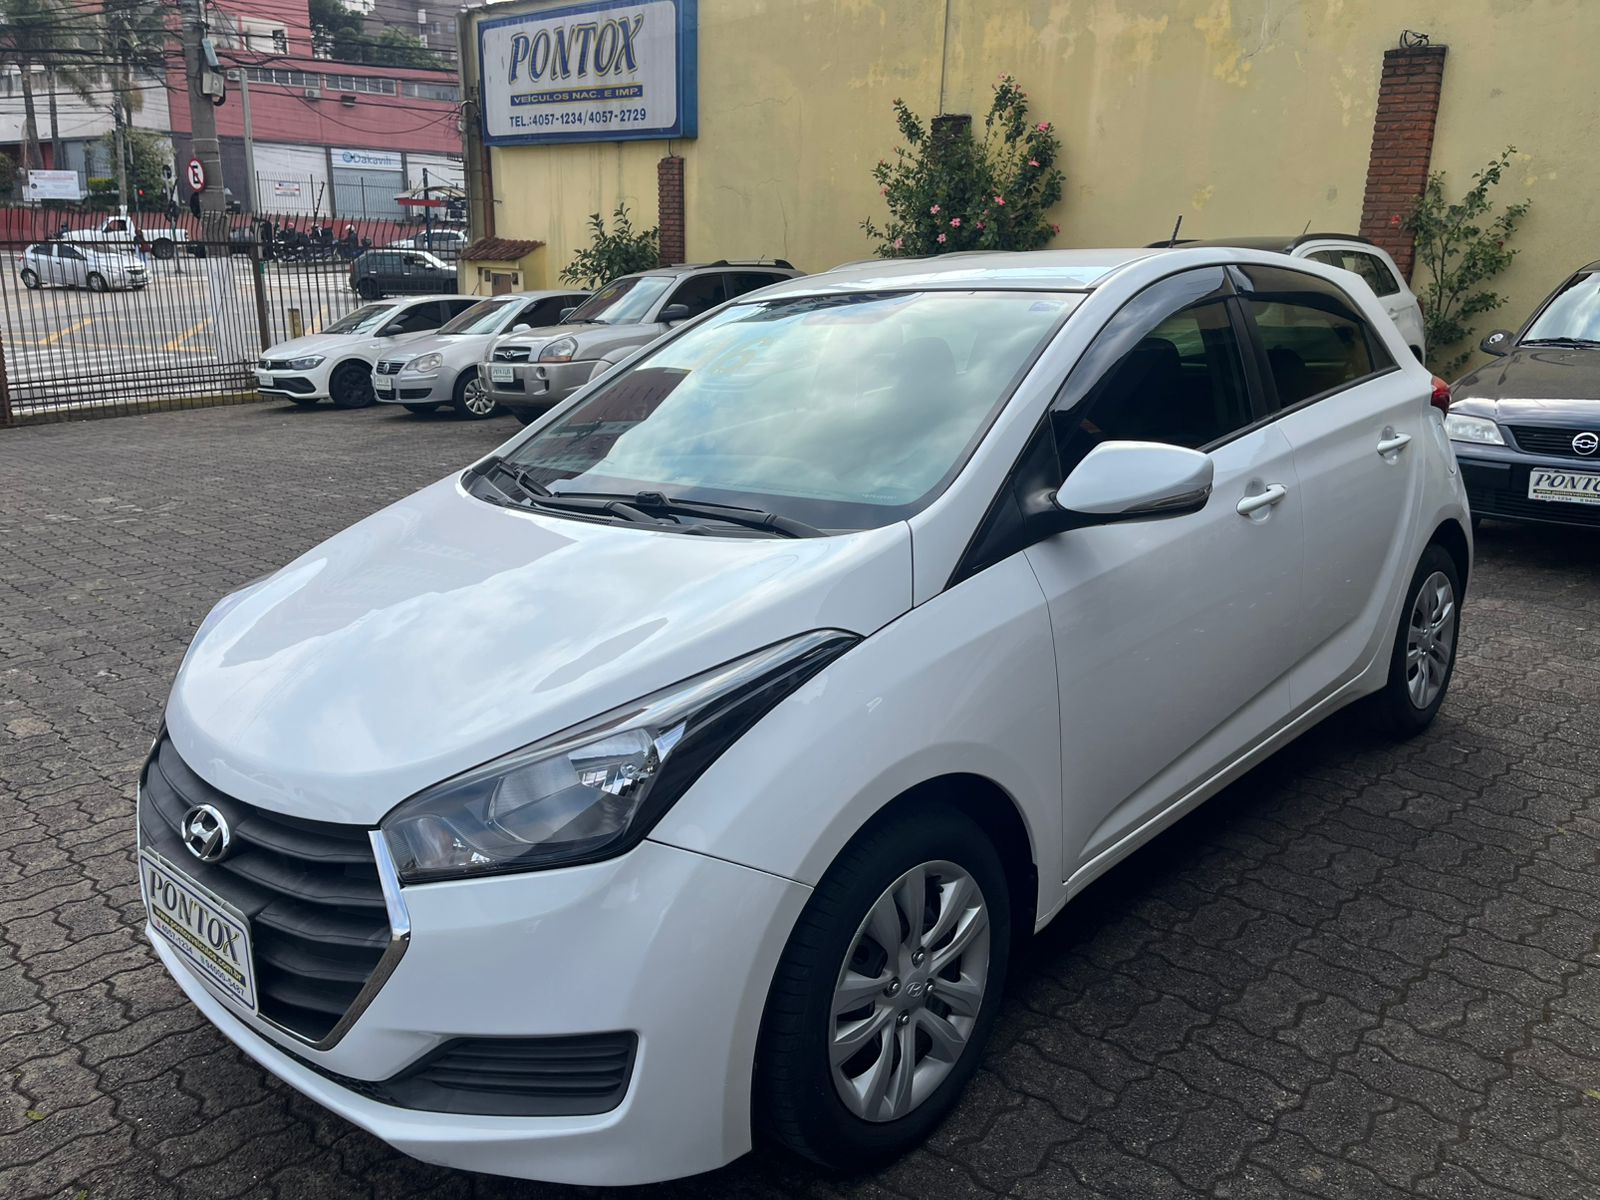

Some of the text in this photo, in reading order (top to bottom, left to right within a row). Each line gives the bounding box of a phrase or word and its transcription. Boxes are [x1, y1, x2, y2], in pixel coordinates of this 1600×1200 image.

[508, 13, 644, 85] PONTOX
[616, 87, 640, 96] IMP.
[148, 867, 241, 967] PONTOX
